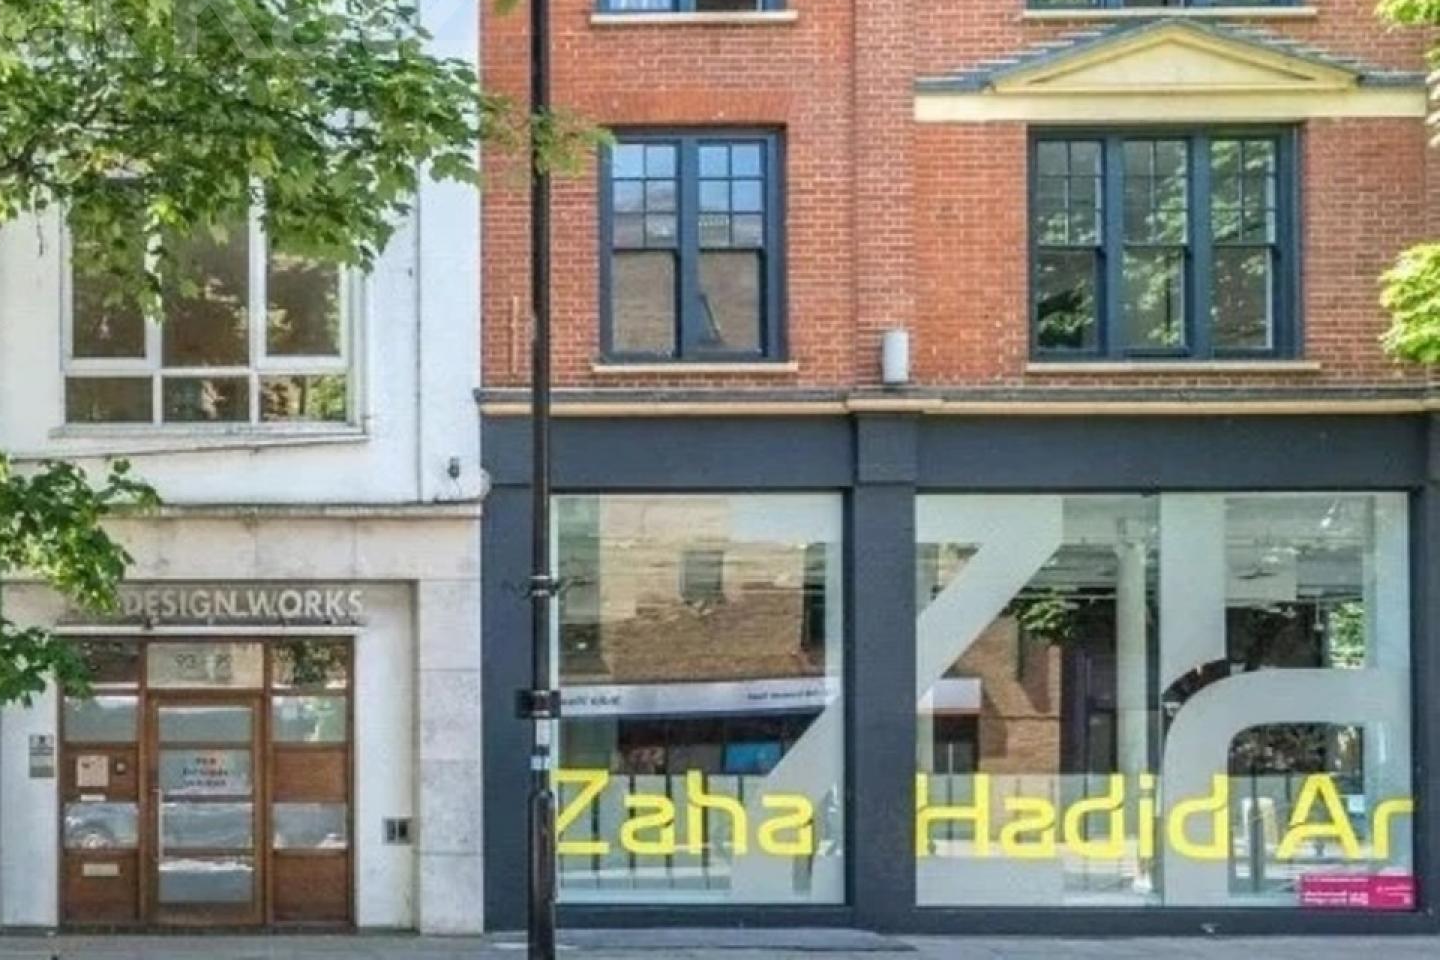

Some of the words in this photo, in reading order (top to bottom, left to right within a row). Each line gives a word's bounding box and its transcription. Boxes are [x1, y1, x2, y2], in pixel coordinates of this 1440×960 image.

[552, 769, 815, 855] Zaha
[915, 774, 1229, 859] Hadid
[1275, 774, 1414, 859] Ar
